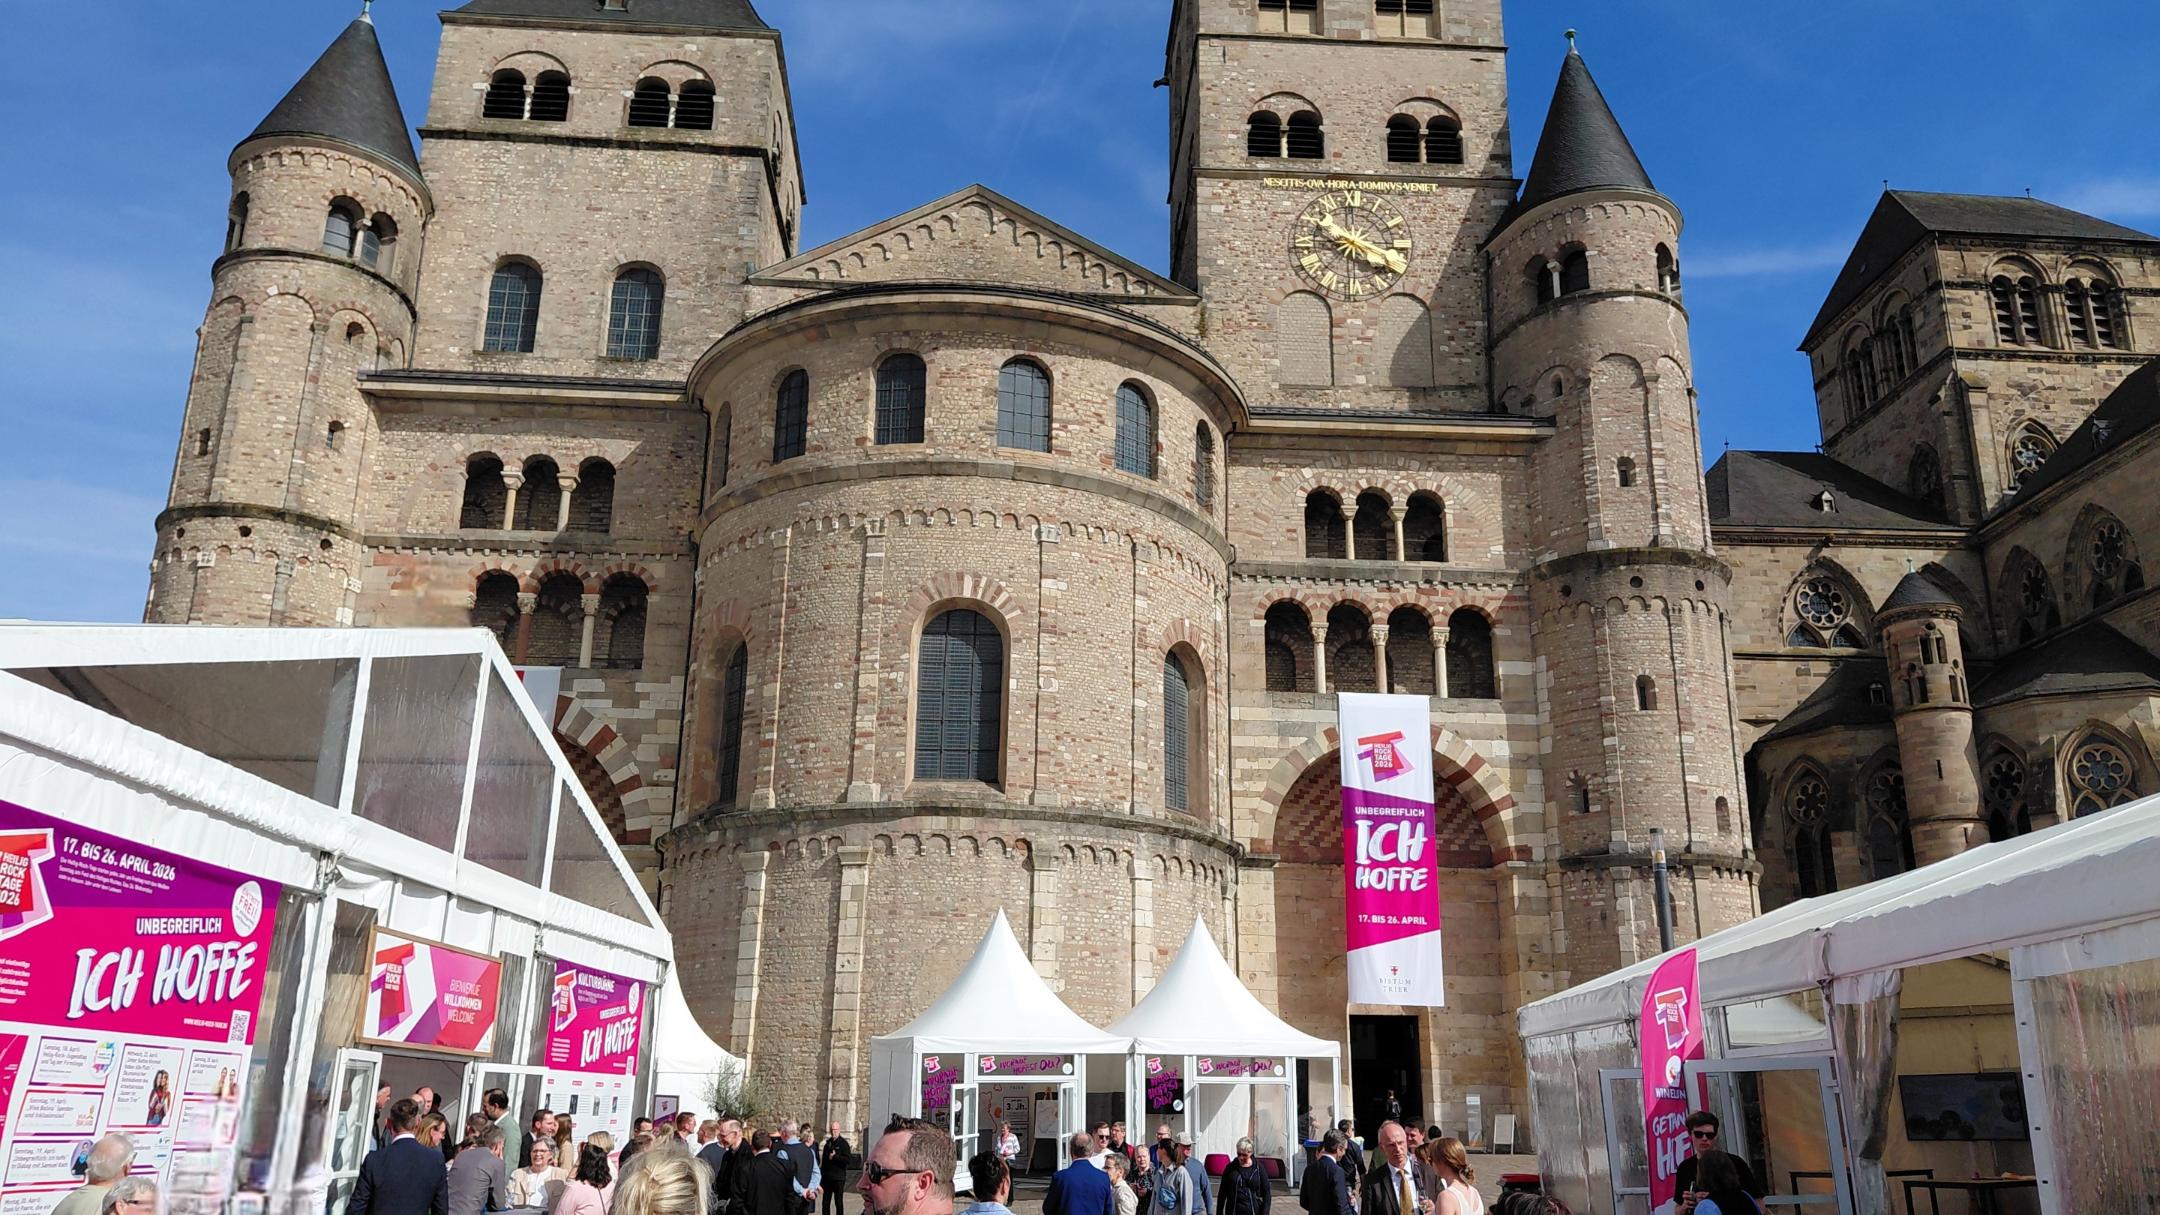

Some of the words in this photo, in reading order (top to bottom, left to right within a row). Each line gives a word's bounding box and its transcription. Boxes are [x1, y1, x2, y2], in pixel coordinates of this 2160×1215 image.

[1354, 806, 1425, 817] UNBEGREIFLICH
[1354, 819, 1429, 865] ICH
[2, 852, 29, 867] HEILIG
[63, 836, 79, 855] 17.
[81, 842, 102, 861] BIS
[101, 848, 118, 866] 26.
[119, 853, 152, 875] APRIL
[152, 862, 176, 881] 2026
[0, 862, 28, 879] ROCK
[1355, 865, 1429, 892] HOFFE
[0, 889, 20, 906] 026
[136, 917, 222, 935] UNBEGREIFLICH
[1358, 914, 1370, 923] 17.
[1372, 914, 1386, 924] BIS
[1387, 915, 1400, 924] 26.
[1401, 916, 1428, 925] APRIL
[67, 946, 144, 1019] ICH
[152, 941, 258, 1004] HOFFE
[444, 992, 482, 1011] WILLKOMMEN
[447, 1009, 476, 1025] WELCOME
[580, 1026, 603, 1068] ICH
[604, 1016, 638, 1057] HOFFE
